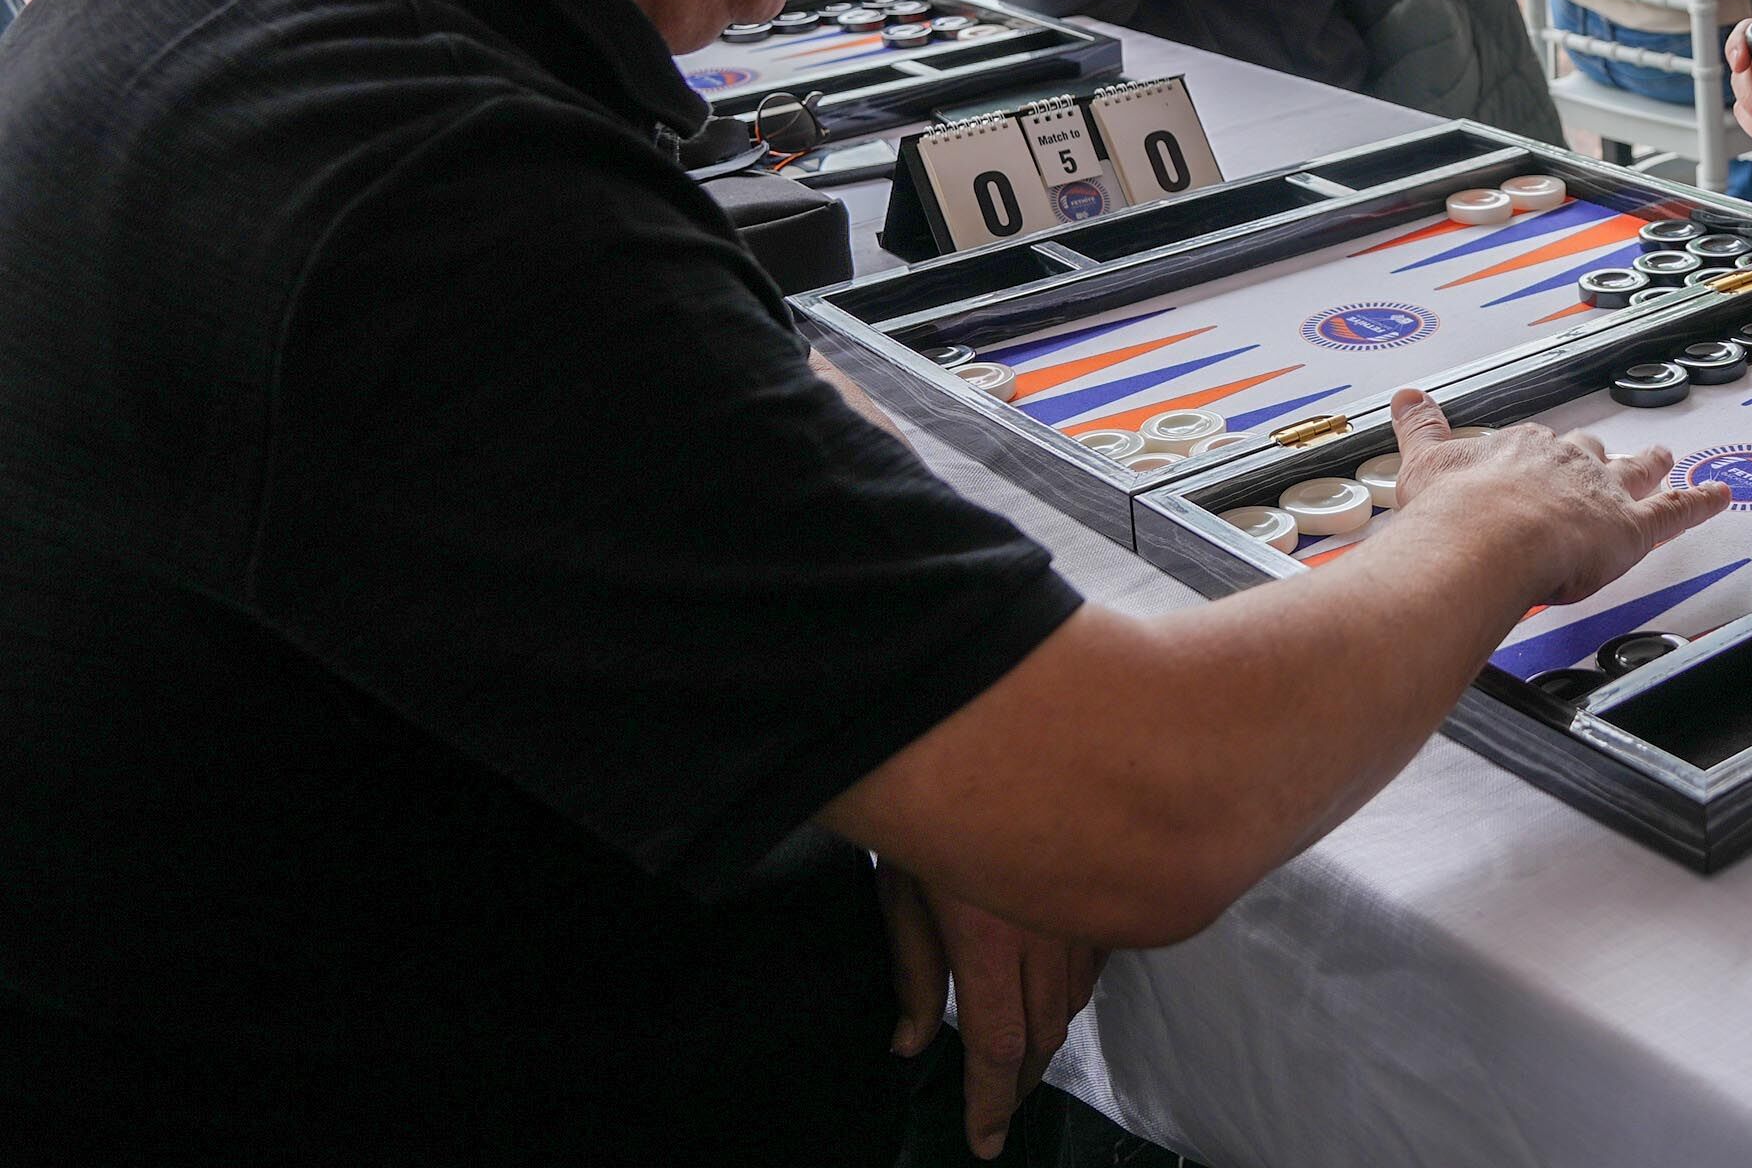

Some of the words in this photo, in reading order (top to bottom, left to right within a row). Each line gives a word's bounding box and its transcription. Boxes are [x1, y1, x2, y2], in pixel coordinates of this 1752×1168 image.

[1038, 130, 1067, 147] Match
[1069, 128, 1081, 141] to
[1058, 148, 1078, 174] 5
[1144, 130, 1191, 193] 0
[972, 170, 1024, 237] 0
